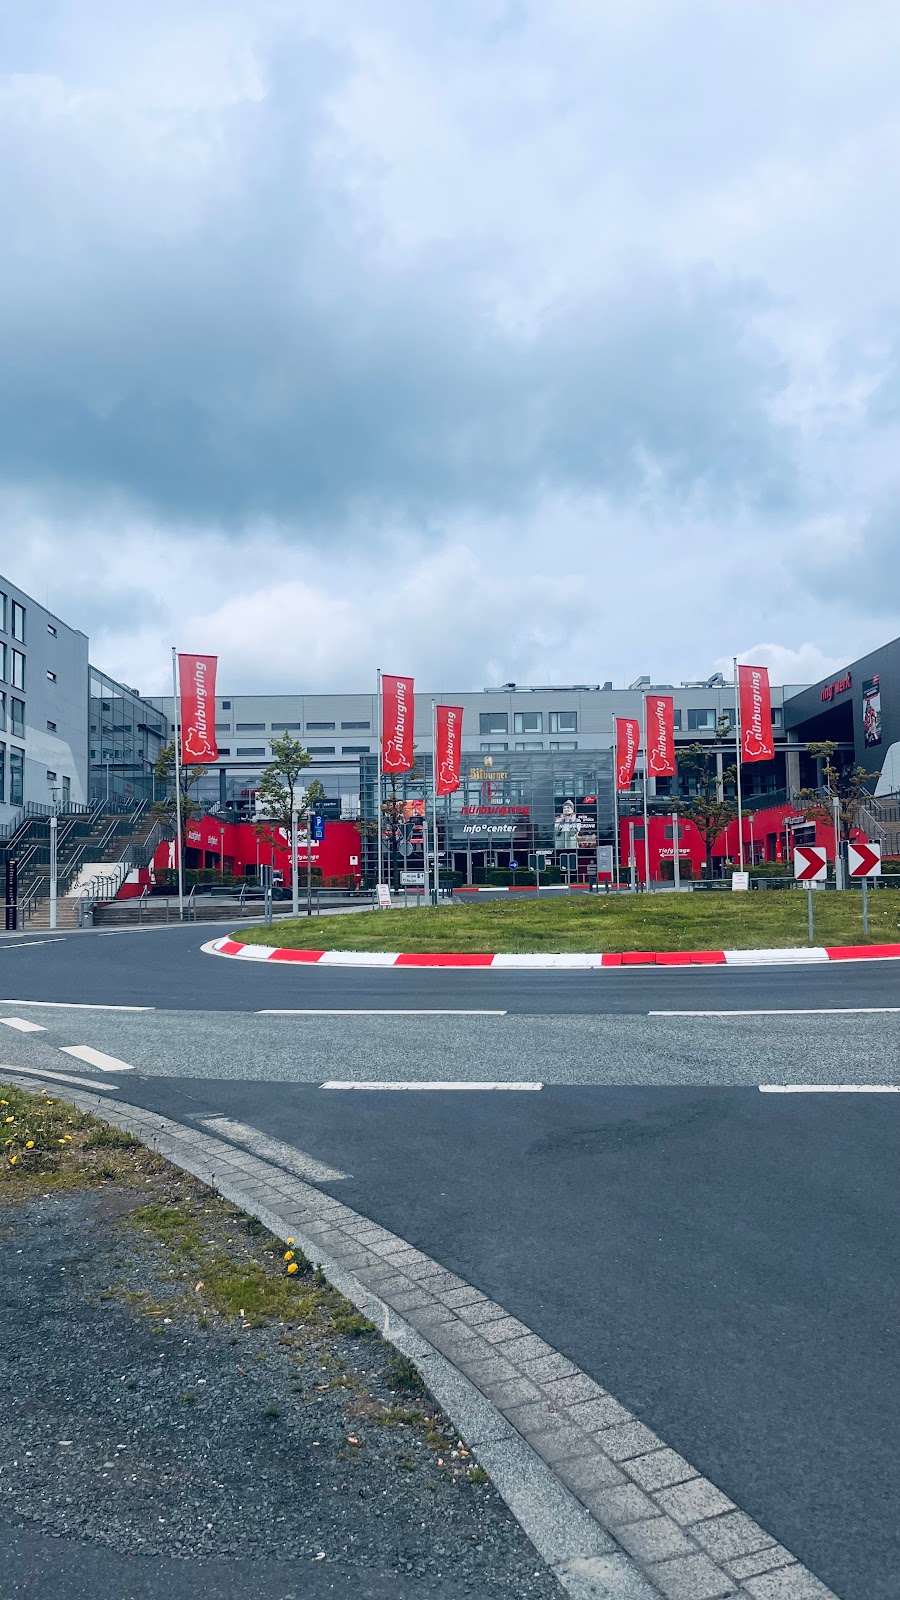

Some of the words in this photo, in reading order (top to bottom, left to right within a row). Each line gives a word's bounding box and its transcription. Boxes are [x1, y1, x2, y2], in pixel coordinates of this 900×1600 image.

[193, 661, 207, 739] nürburgring
[393, 681, 408, 752] nürburgring
[655, 700, 667, 759] nürburgring
[750, 671, 762, 741] nürburgring
[446, 711, 456, 772] nürburgring
[460, 804, 530, 817] nürburgring
[658, 847, 690, 855] Tiefgrage
